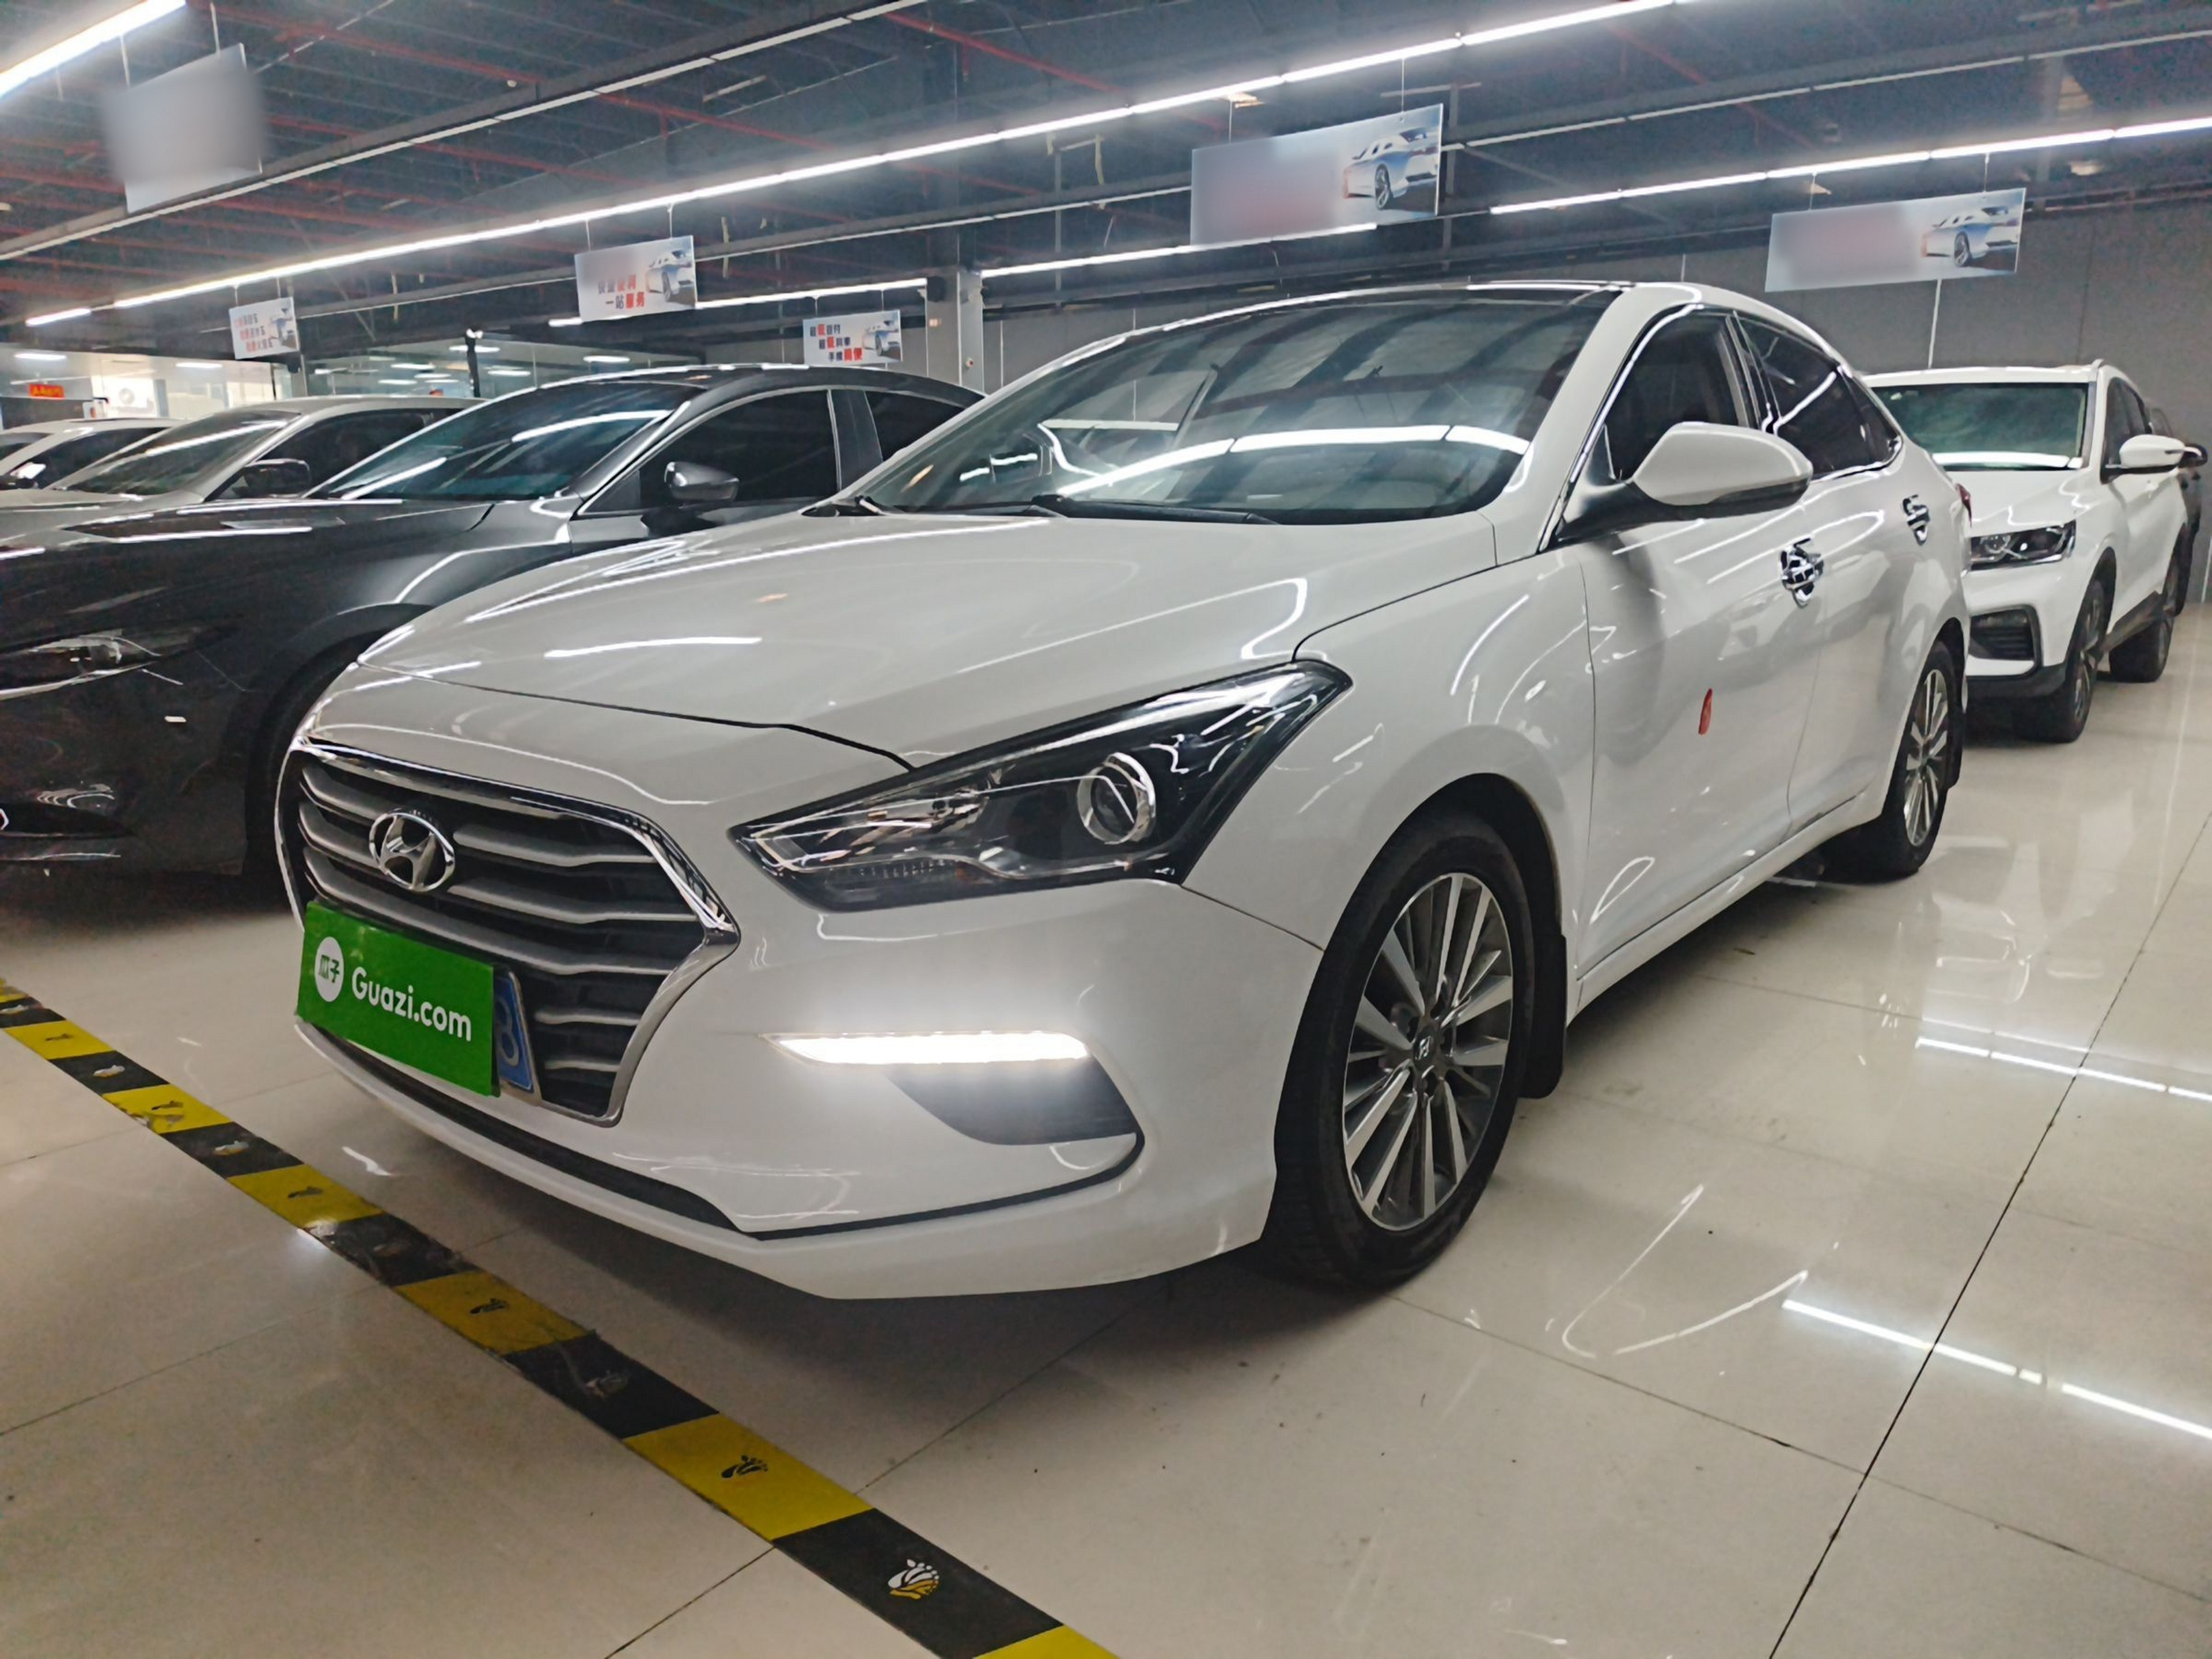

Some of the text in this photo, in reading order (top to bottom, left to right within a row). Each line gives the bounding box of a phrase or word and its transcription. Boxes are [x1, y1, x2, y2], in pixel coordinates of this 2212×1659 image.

[606, 291, 645, 309] 一站服务
[318, 954, 340, 983] 瓜子
[351, 967, 472, 1041] Guazi.com
